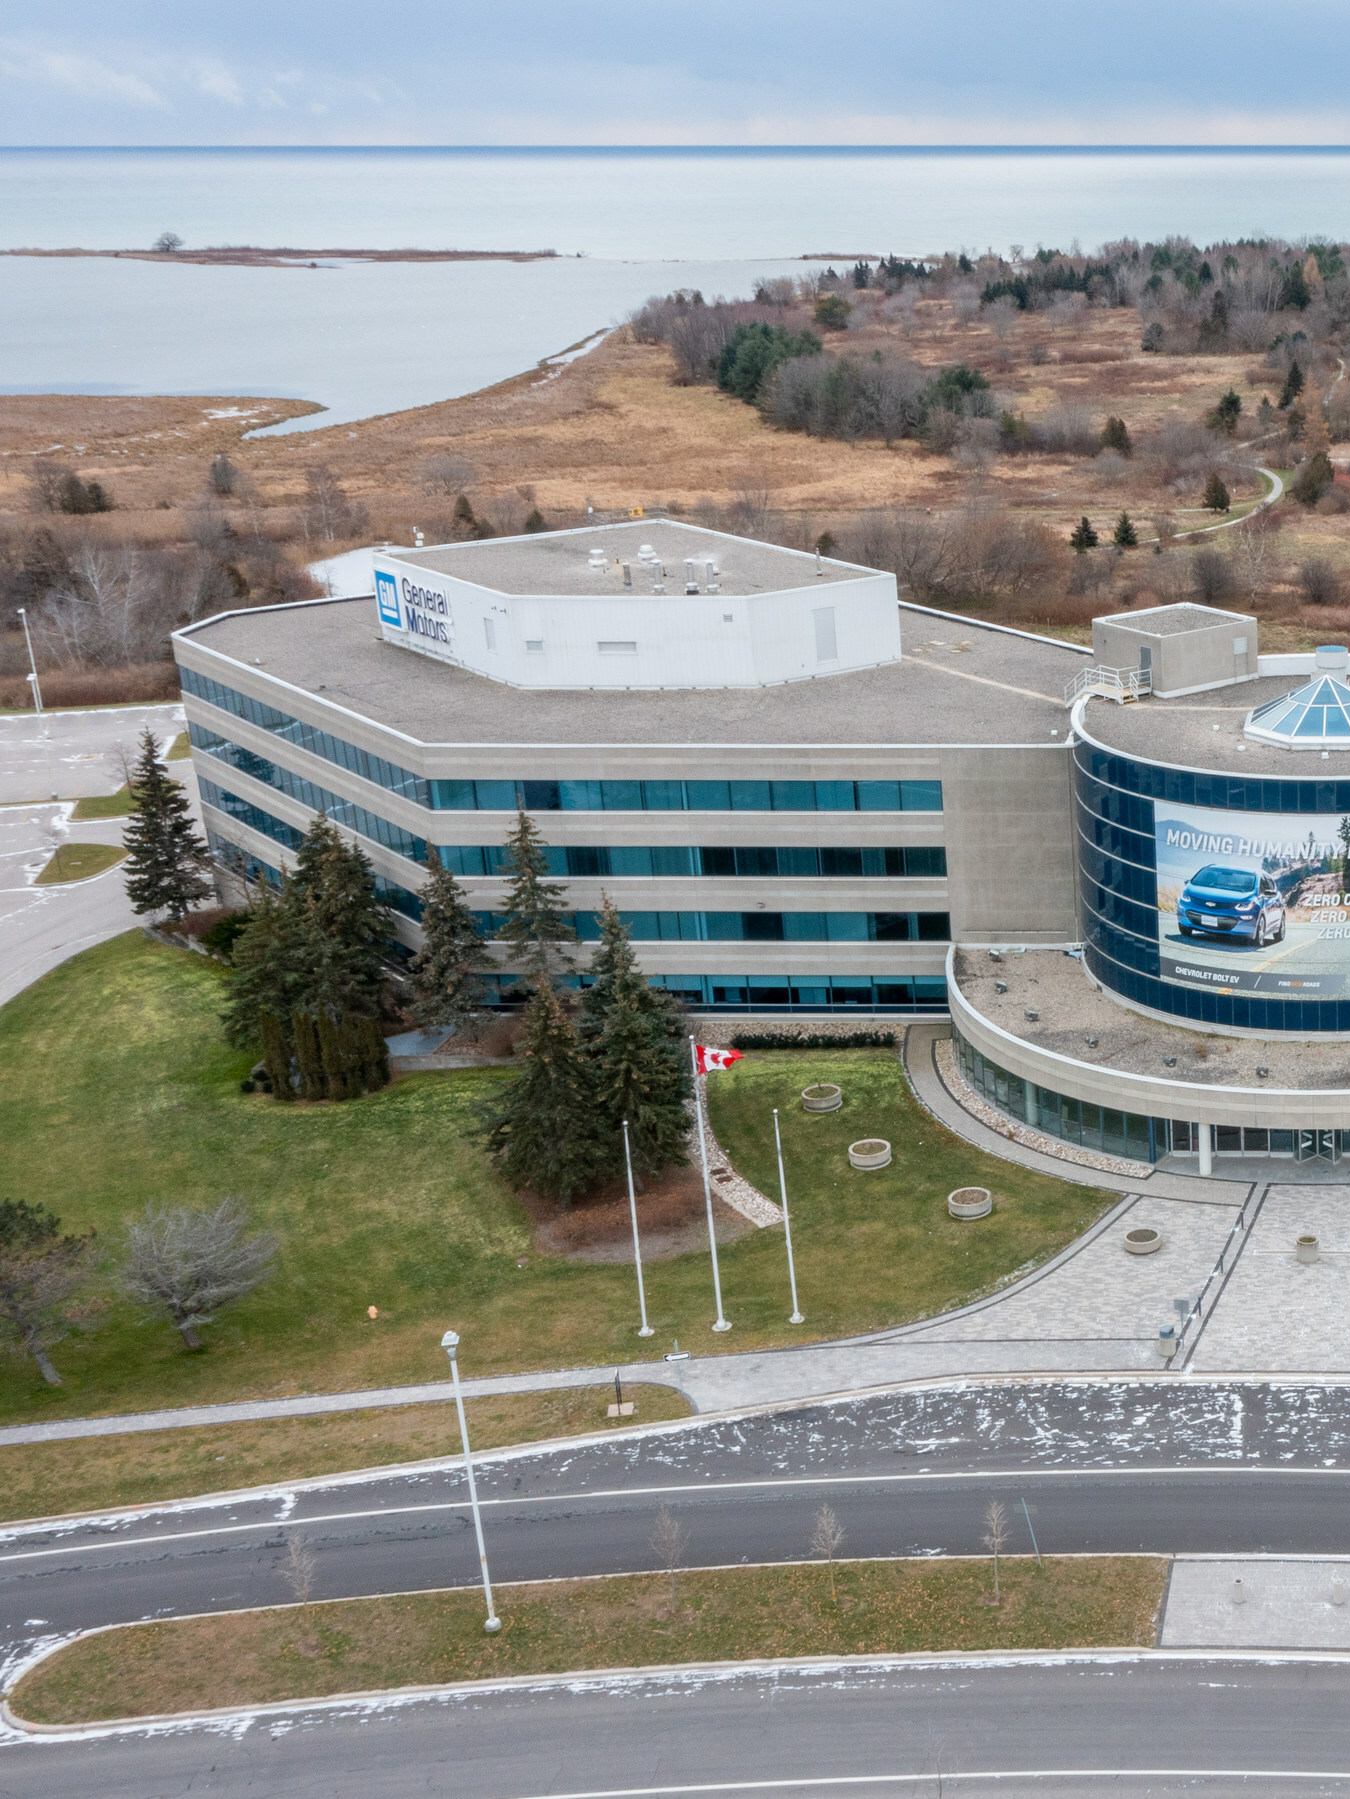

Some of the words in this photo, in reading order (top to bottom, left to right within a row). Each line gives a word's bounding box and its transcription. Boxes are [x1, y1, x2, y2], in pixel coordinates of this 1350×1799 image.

[378, 580, 397, 610] GM
[401, 577, 449, 616] General
[405, 605, 448, 643] Motors
[1166, 828, 1233, 856] MOVING
[1237, 839, 1345, 861] HUMANITY
[1303, 893, 1341, 907] ZERO
[1310, 910, 1348, 923] ZERO
[1175, 966, 1213, 980] CHEVROLET
[1212, 973, 1230, 983] BOLT
[1229, 975, 1240, 984] EV
